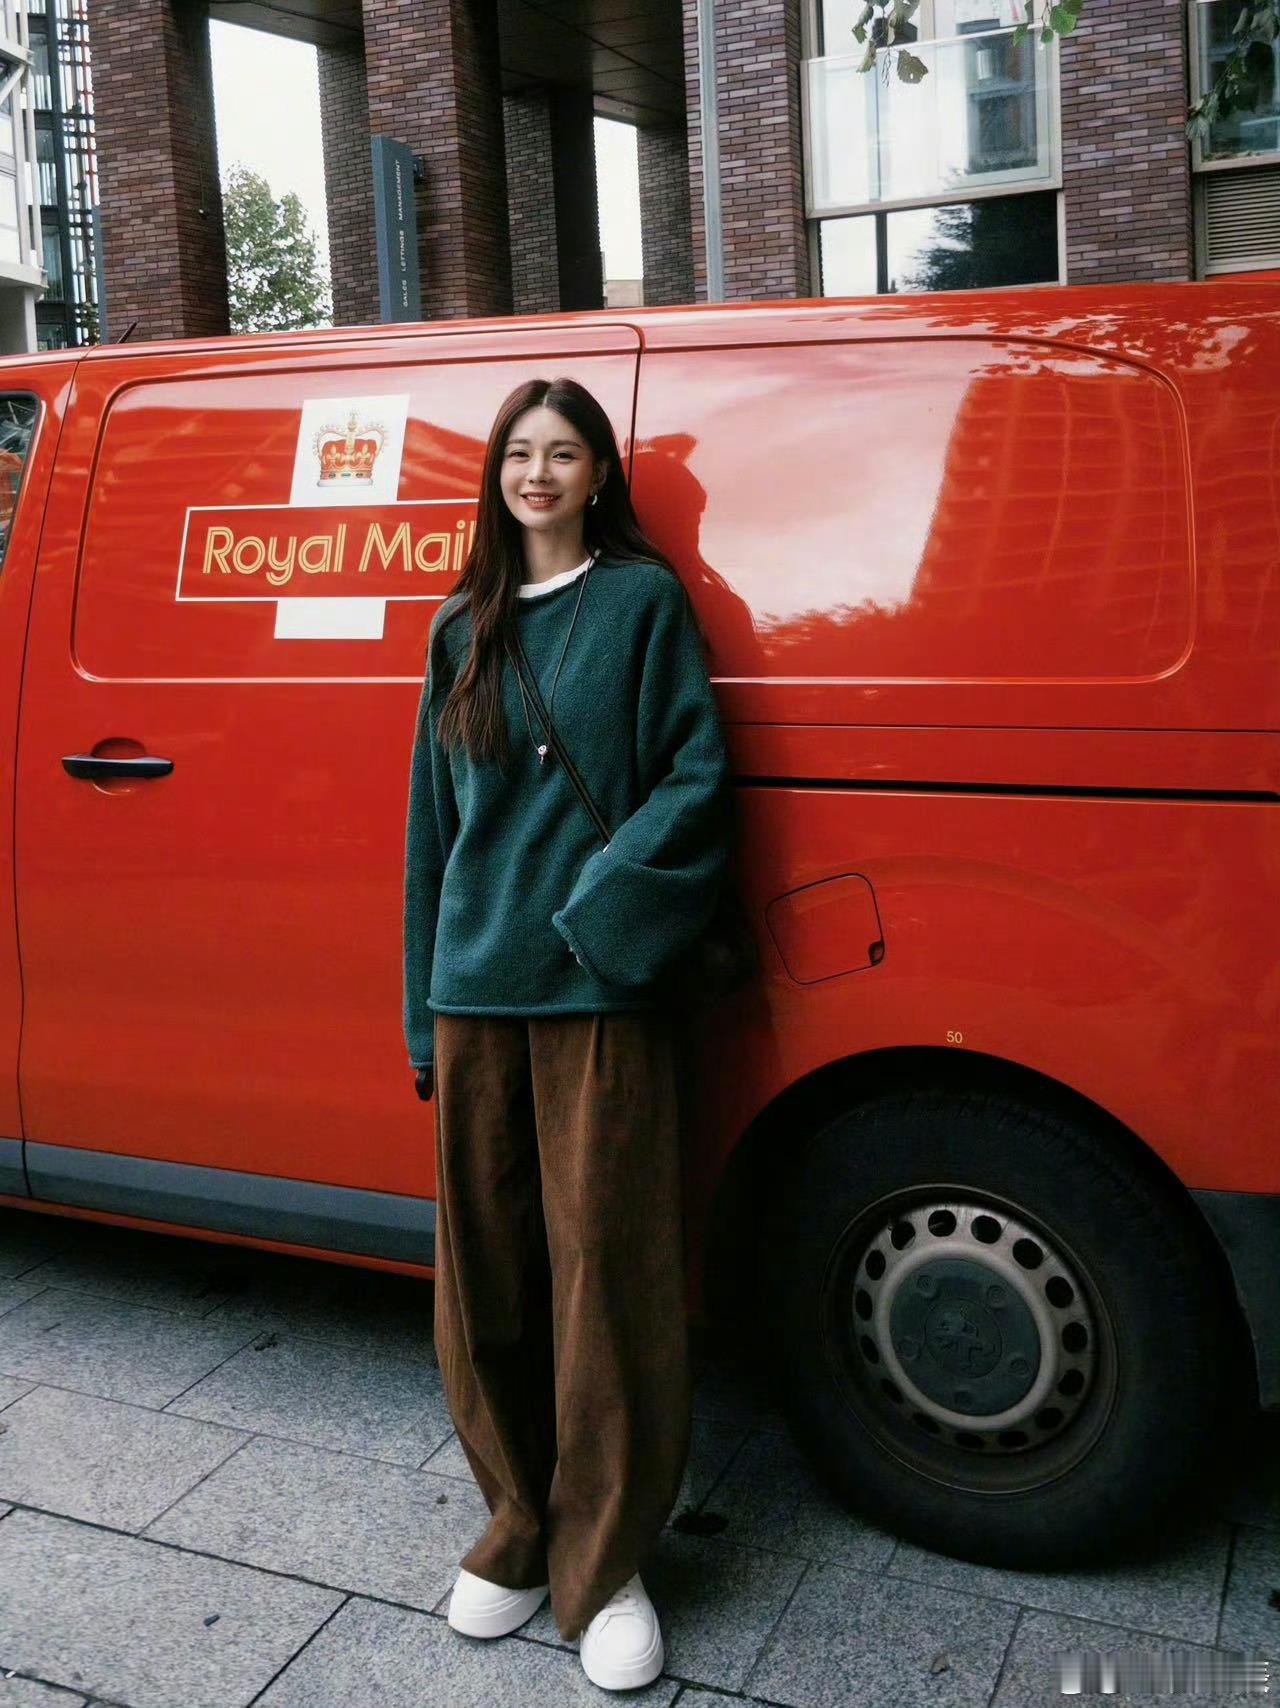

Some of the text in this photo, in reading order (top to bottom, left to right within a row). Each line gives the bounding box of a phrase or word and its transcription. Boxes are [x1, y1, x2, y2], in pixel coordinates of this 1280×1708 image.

[395, 159, 404, 221] MANAGEMENT
[399, 230, 407, 272] LETTINGS
[202, 523, 347, 586] Royal
[946, 1030, 963, 1044] 50
